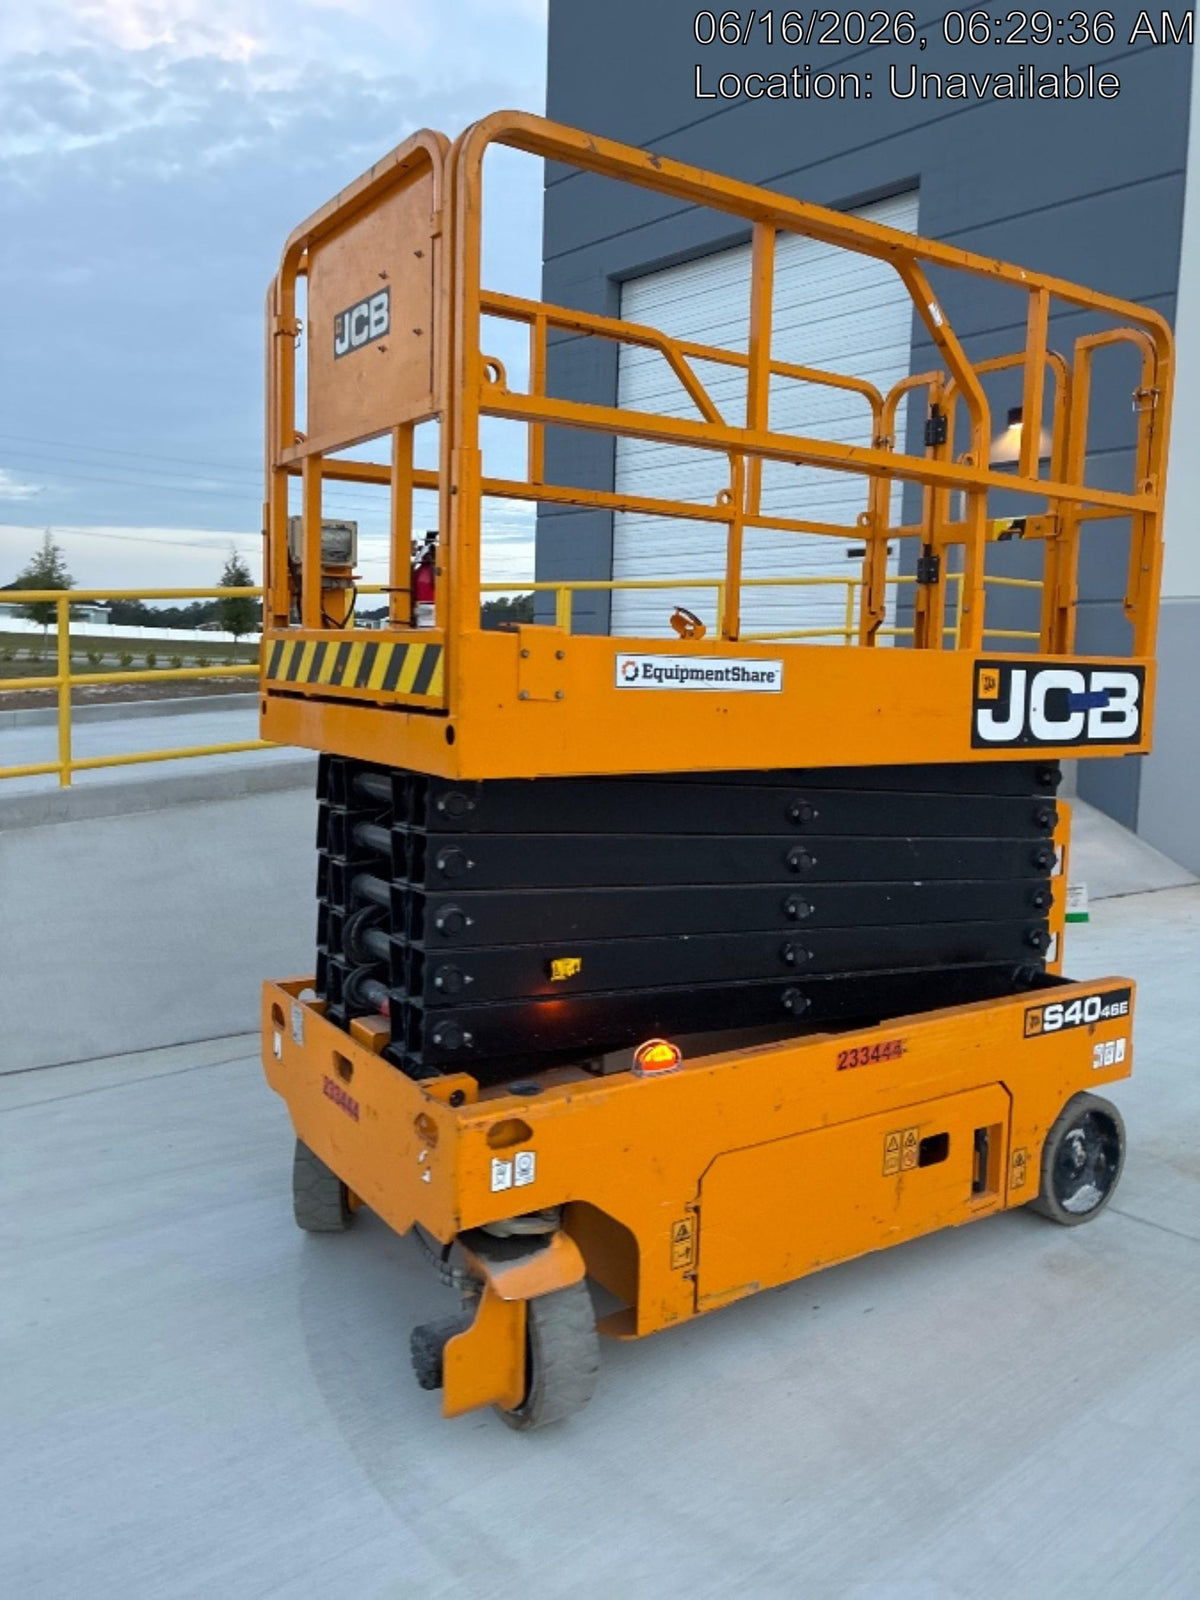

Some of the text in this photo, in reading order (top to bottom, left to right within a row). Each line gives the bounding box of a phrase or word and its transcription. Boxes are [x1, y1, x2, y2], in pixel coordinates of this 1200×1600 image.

[335, 292, 389, 355] JCB
[642, 662, 775, 684] EquipmentShare
[977, 669, 1140, 742] JCB
